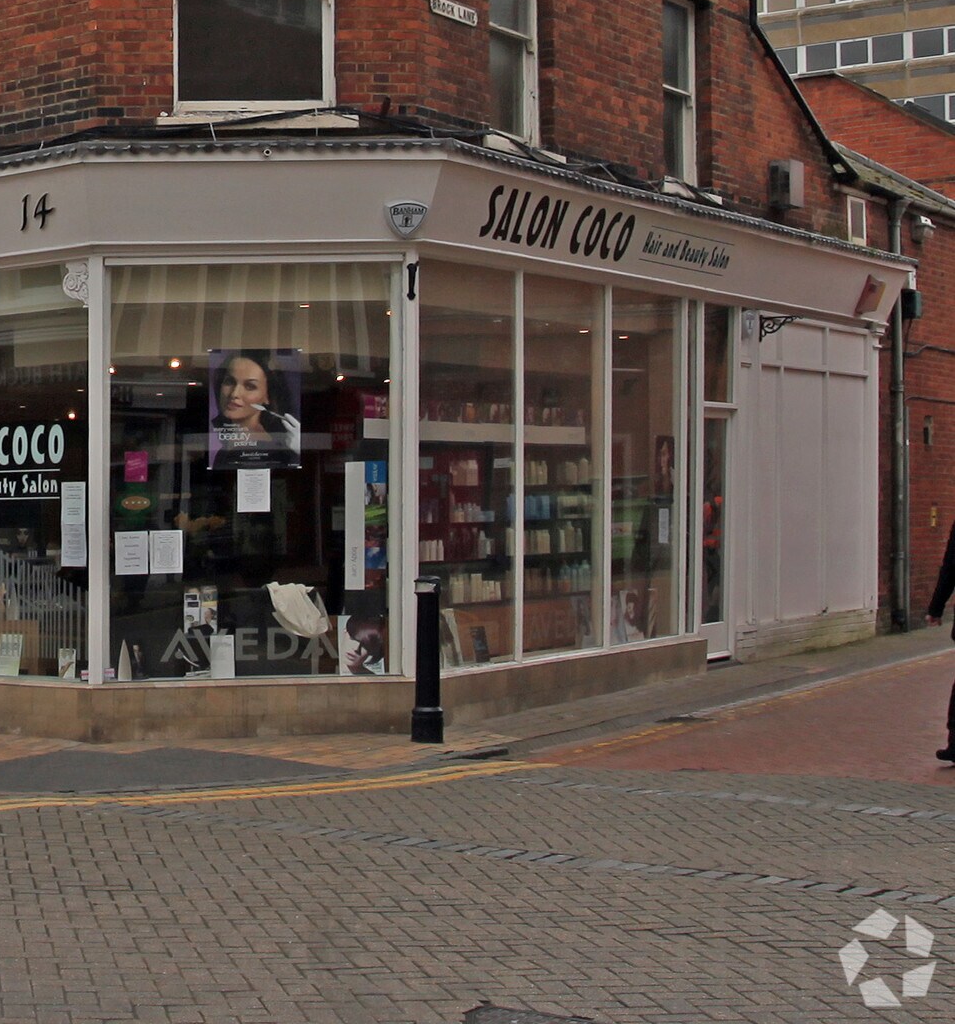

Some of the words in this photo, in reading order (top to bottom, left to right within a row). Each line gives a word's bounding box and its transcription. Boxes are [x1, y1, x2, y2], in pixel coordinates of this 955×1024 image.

[457, 6, 476, 24] LANE
[20, 192, 55, 232] 14
[392, 206, 424, 216] BANHAM
[478, 184, 570, 250] SALON
[569, 205, 636, 261] COCO
[641, 231, 663, 256] Hair
[662, 238, 679, 259] and
[679, 241, 709, 268] Beauty
[709, 245, 731, 269] Salon
[218, 431, 251, 442] beauty
[21, 473, 59, 494] Salon
